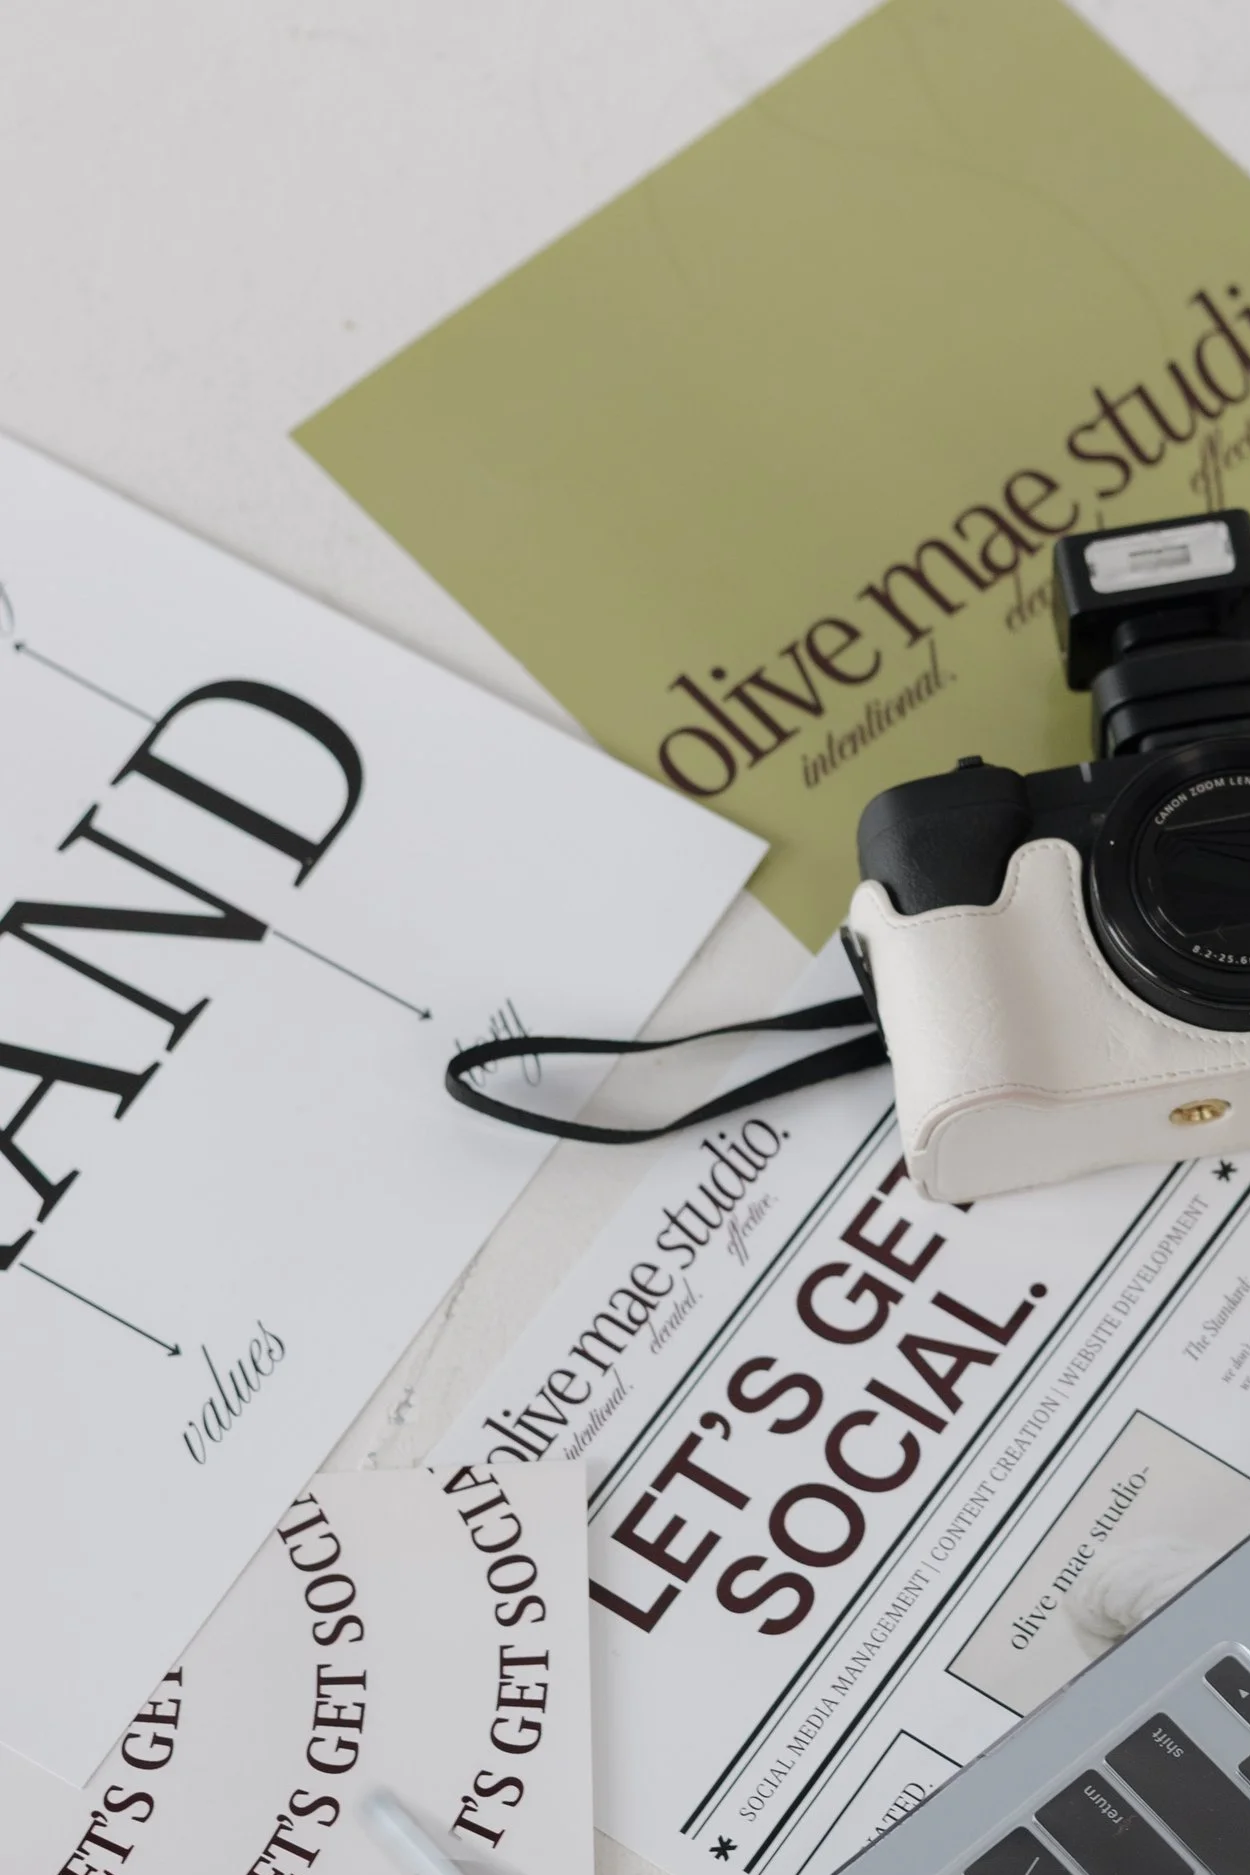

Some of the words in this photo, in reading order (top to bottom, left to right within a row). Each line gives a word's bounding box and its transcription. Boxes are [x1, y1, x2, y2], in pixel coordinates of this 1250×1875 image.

[657, 617, 882, 800] olive
[858, 470, 1080, 648] mae
[801, 642, 958, 790] intentional.
[1154, 792, 1189, 826] CANON
[1188, 776, 1227, 798] ZOOM
[0, 677, 366, 1272] AND
[567, 1260, 676, 1378] mae
[655, 1115, 792, 1272] studio.
[182, 1319, 286, 1465] values
[1181, 1333, 1212, 1364] The
[588, 1356, 824, 1634] LET'S
[715, 1282, 1049, 1636] SOCIAL.
[737, 1758, 797, 1824] SOCIAL
[784, 1696, 842, 1758] MEDIA
[829, 1568, 931, 1698] MANAGEMENT
[929, 1479, 997, 1563] CONTENT
[988, 1394, 1062, 1483] CREATION
[1056, 1316, 1122, 1387] WEBSITE
[1111, 1193, 1210, 1317] DEVELOPMENT
[275, 1489, 367, 1648] SOCI
[426, 1464, 548, 1636] SOCIA
[1009, 1594, 1059, 1652] olive
[1050, 1542, 1096, 1596] mae
[305, 1663, 368, 1776] GET
[489, 1644, 549, 1755] GET
[1150, 1726, 1186, 1759] shift
[1082, 1784, 1125, 1825] return
